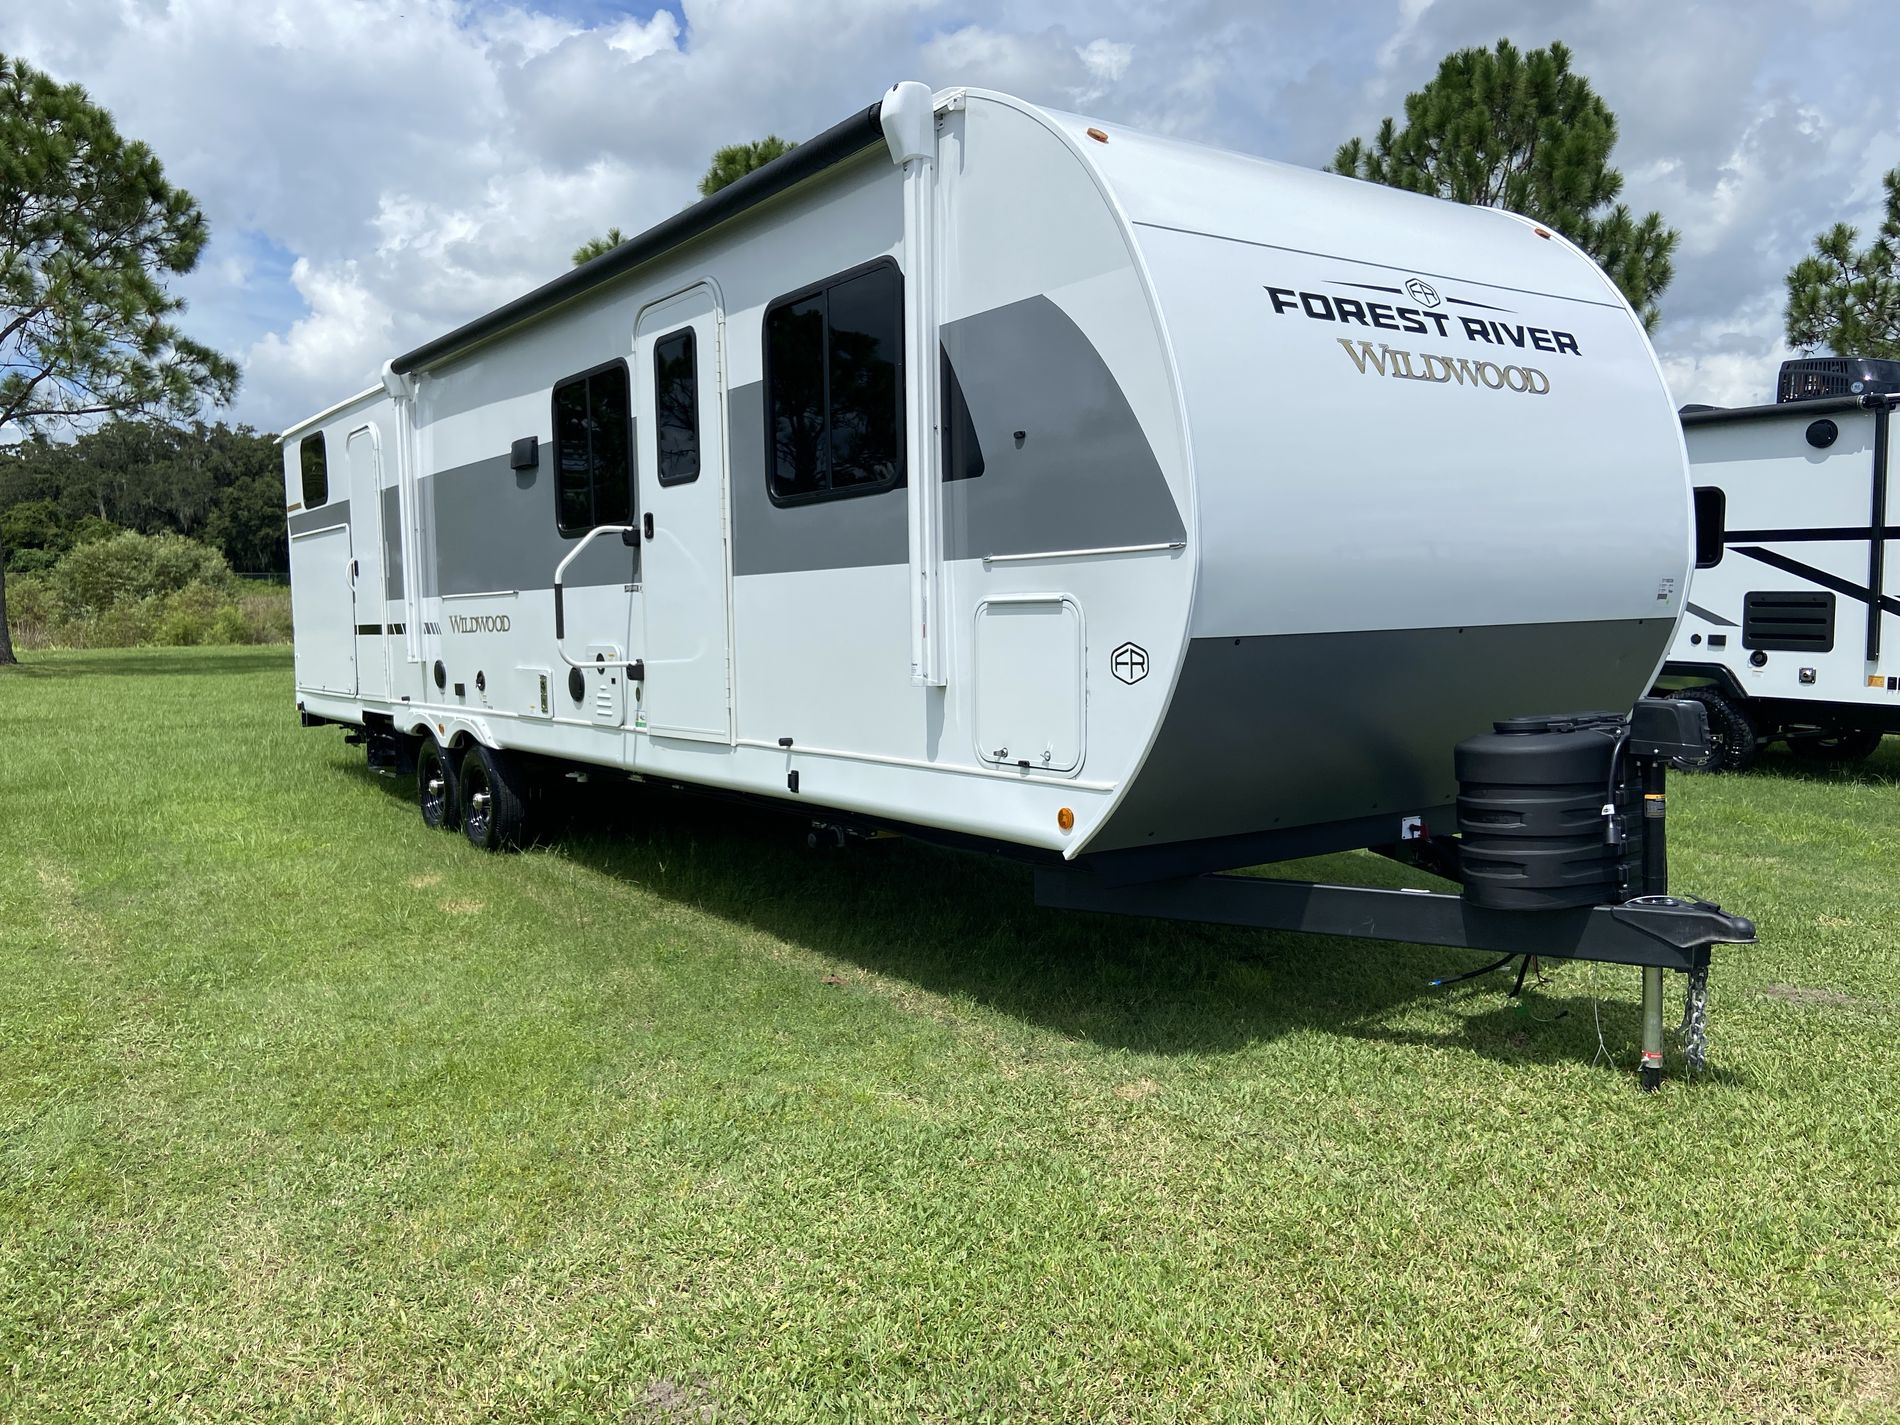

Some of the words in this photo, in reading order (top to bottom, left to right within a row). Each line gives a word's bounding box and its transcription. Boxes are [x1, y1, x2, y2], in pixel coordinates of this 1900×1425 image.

[1263, 286, 1449, 337] FOREST
[1457, 316, 1583, 356] RIVER
[1337, 338, 1550, 395] WILDWOOD
[449, 615, 510, 634] WILDWOOD
